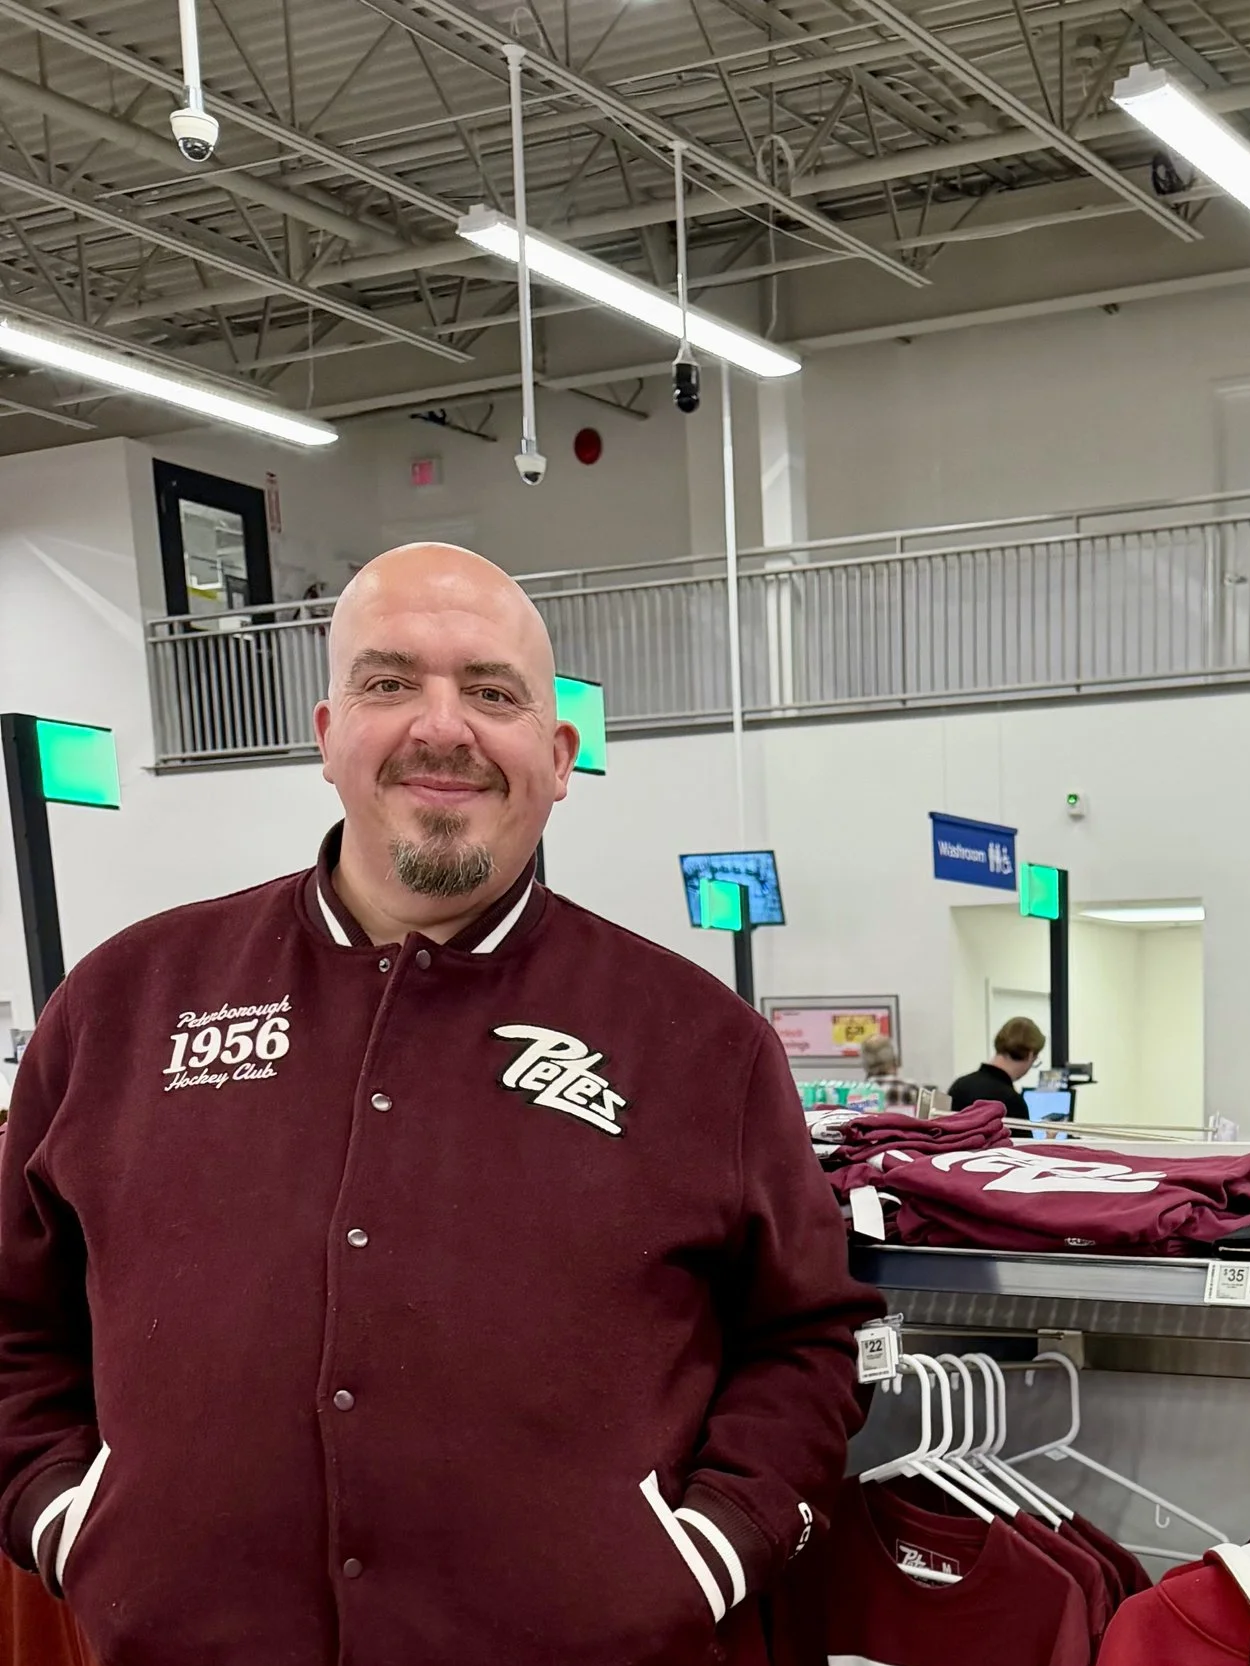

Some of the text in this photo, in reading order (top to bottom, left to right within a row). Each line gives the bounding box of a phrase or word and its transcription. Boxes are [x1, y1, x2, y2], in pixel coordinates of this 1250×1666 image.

[937, 840, 987, 863] Washroom
[176, 994, 292, 1029] Peterborough
[162, 1017, 290, 1074] 1956
[164, 1062, 278, 1092] Hockey Club
[493, 1023, 628, 1135] Petes
[1223, 1268, 1245, 1282] $35
[864, 1340, 883, 1353] $22
